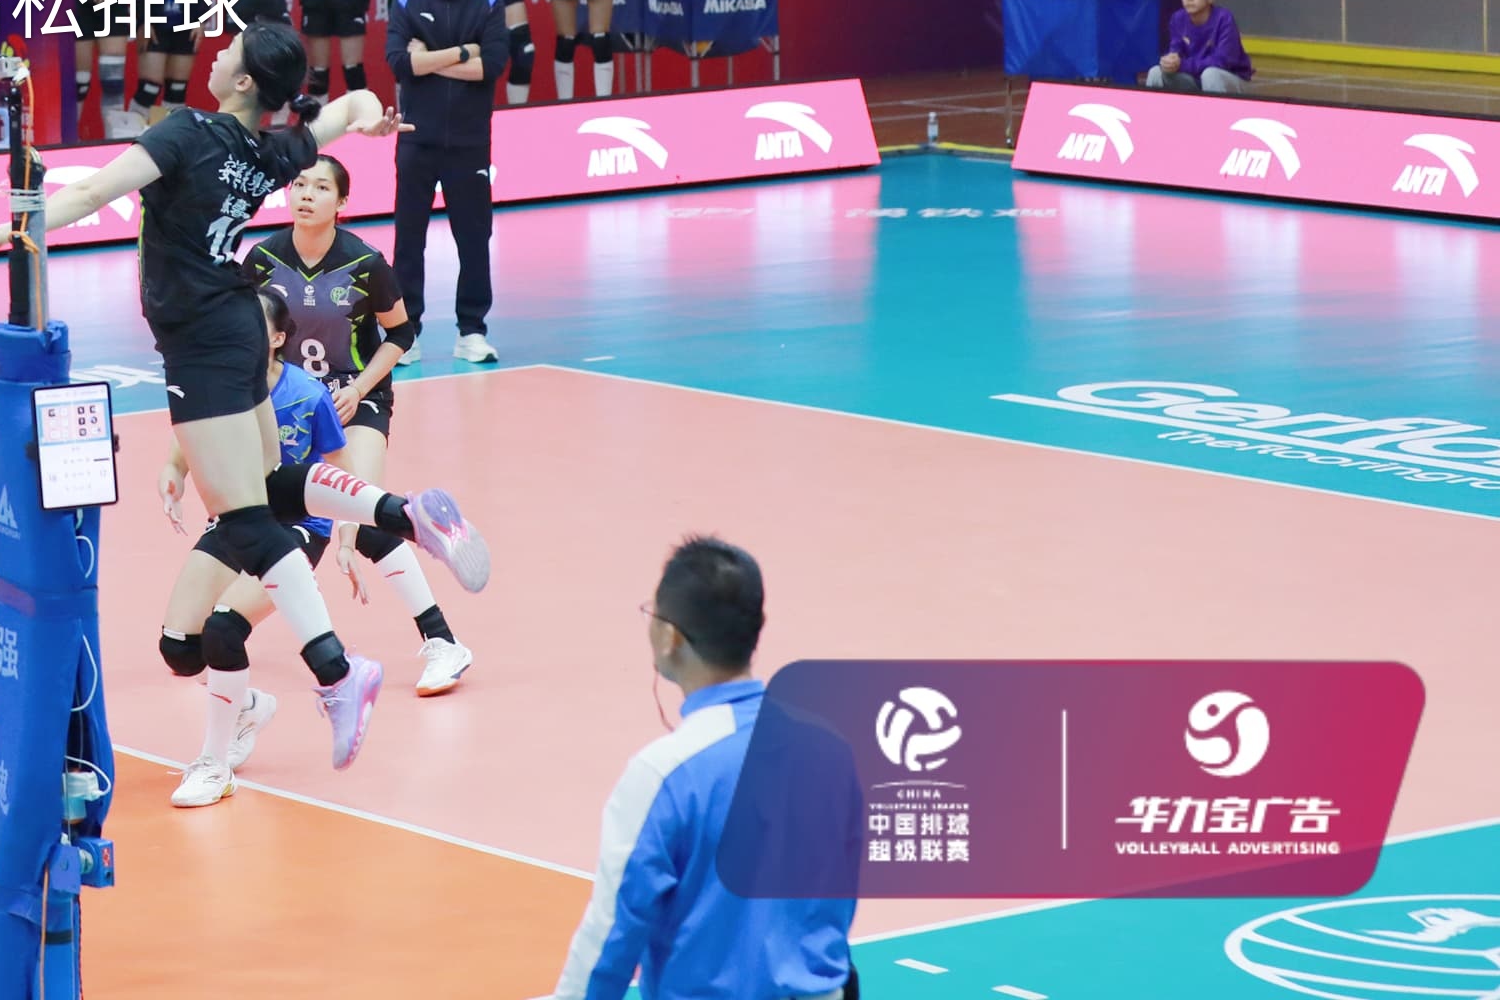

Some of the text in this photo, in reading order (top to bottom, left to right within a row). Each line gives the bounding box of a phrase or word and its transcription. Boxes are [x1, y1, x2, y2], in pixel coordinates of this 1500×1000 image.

[755, 131, 804, 161] ANTA
[1057, 133, 1107, 163] ANTA
[587, 147, 639, 177] ANTA
[1220, 148, 1273, 179] ANTA
[1392, 165, 1448, 197] ANTA
[300, 338, 331, 378] 8
[1056, 380, 1500, 468] Gerflo
